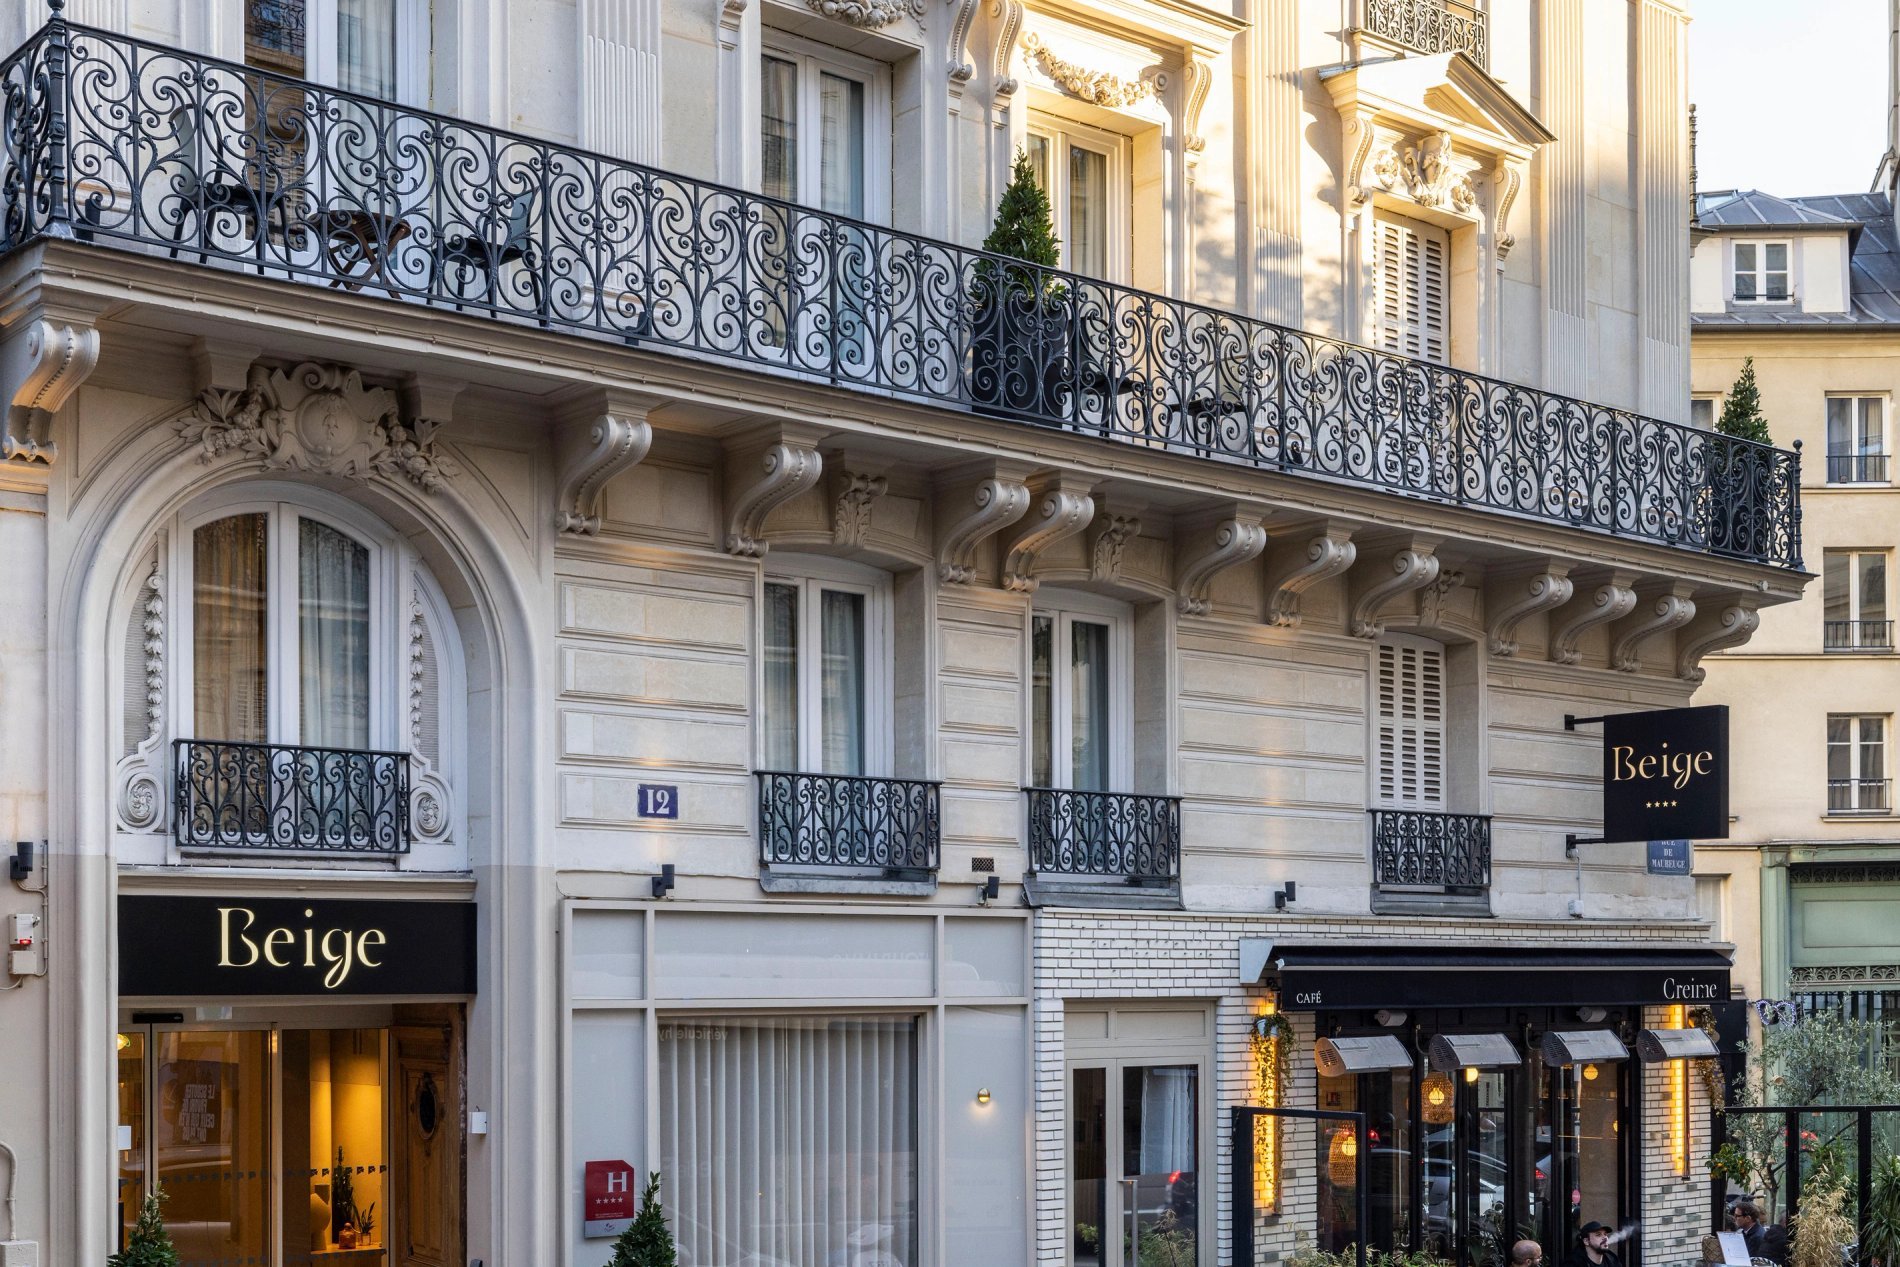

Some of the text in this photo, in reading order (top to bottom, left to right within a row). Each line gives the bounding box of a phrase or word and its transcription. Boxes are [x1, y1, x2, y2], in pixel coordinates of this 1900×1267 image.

[1611, 742, 1713, 790] Beige
[646, 789, 670, 814] 12
[1652, 859, 1685, 868] MAUBEUGE
[1663, 848, 1672, 857] DE
[217, 907, 386, 989] Beige
[1296, 990, 1322, 1004] CAFÉ
[1663, 977, 1717, 1000] Creime
[607, 1172, 628, 1193] H
